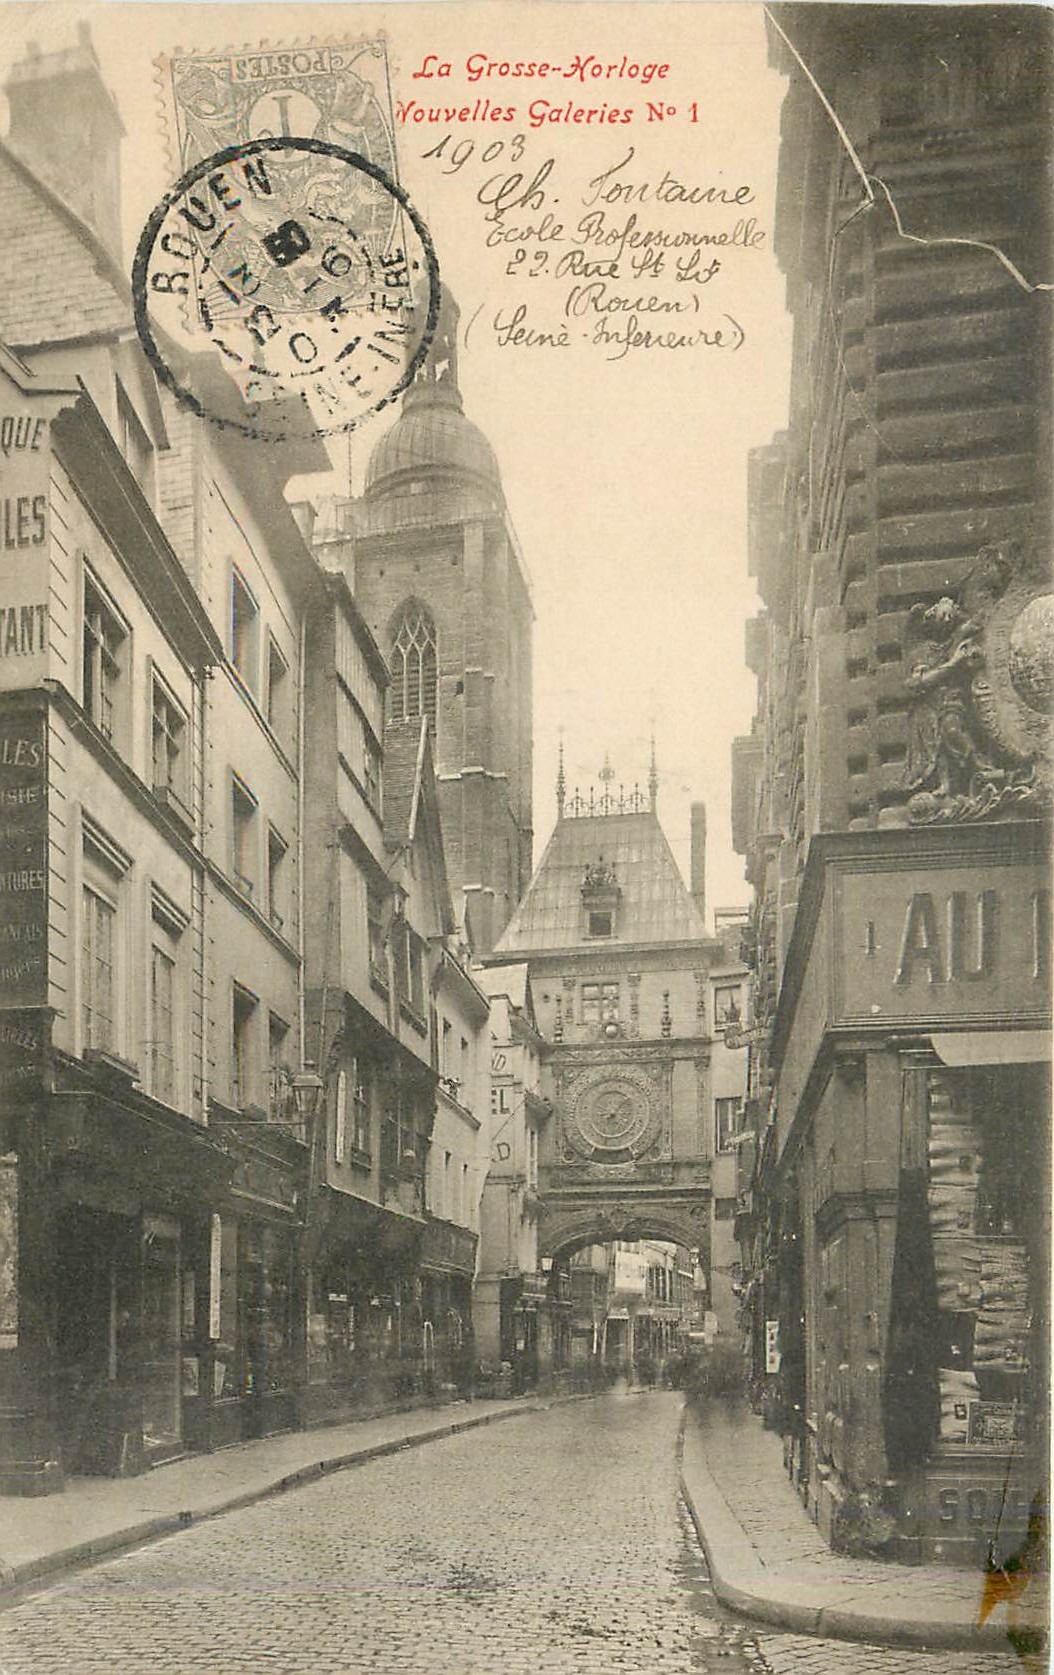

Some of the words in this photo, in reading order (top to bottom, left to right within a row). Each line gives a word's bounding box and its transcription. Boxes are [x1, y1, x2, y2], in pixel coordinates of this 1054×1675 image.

[236, 50, 328, 80] POSTES
[420, 134, 526, 175] 1903
[151, 157, 273, 297] ROUEN
[555, 250, 620, 279] Rue
[1, 416, 46, 457] QUE
[5, 496, 46, 549] LES
[3, 739, 42, 767] LES
[893, 889, 998, 987] AU
